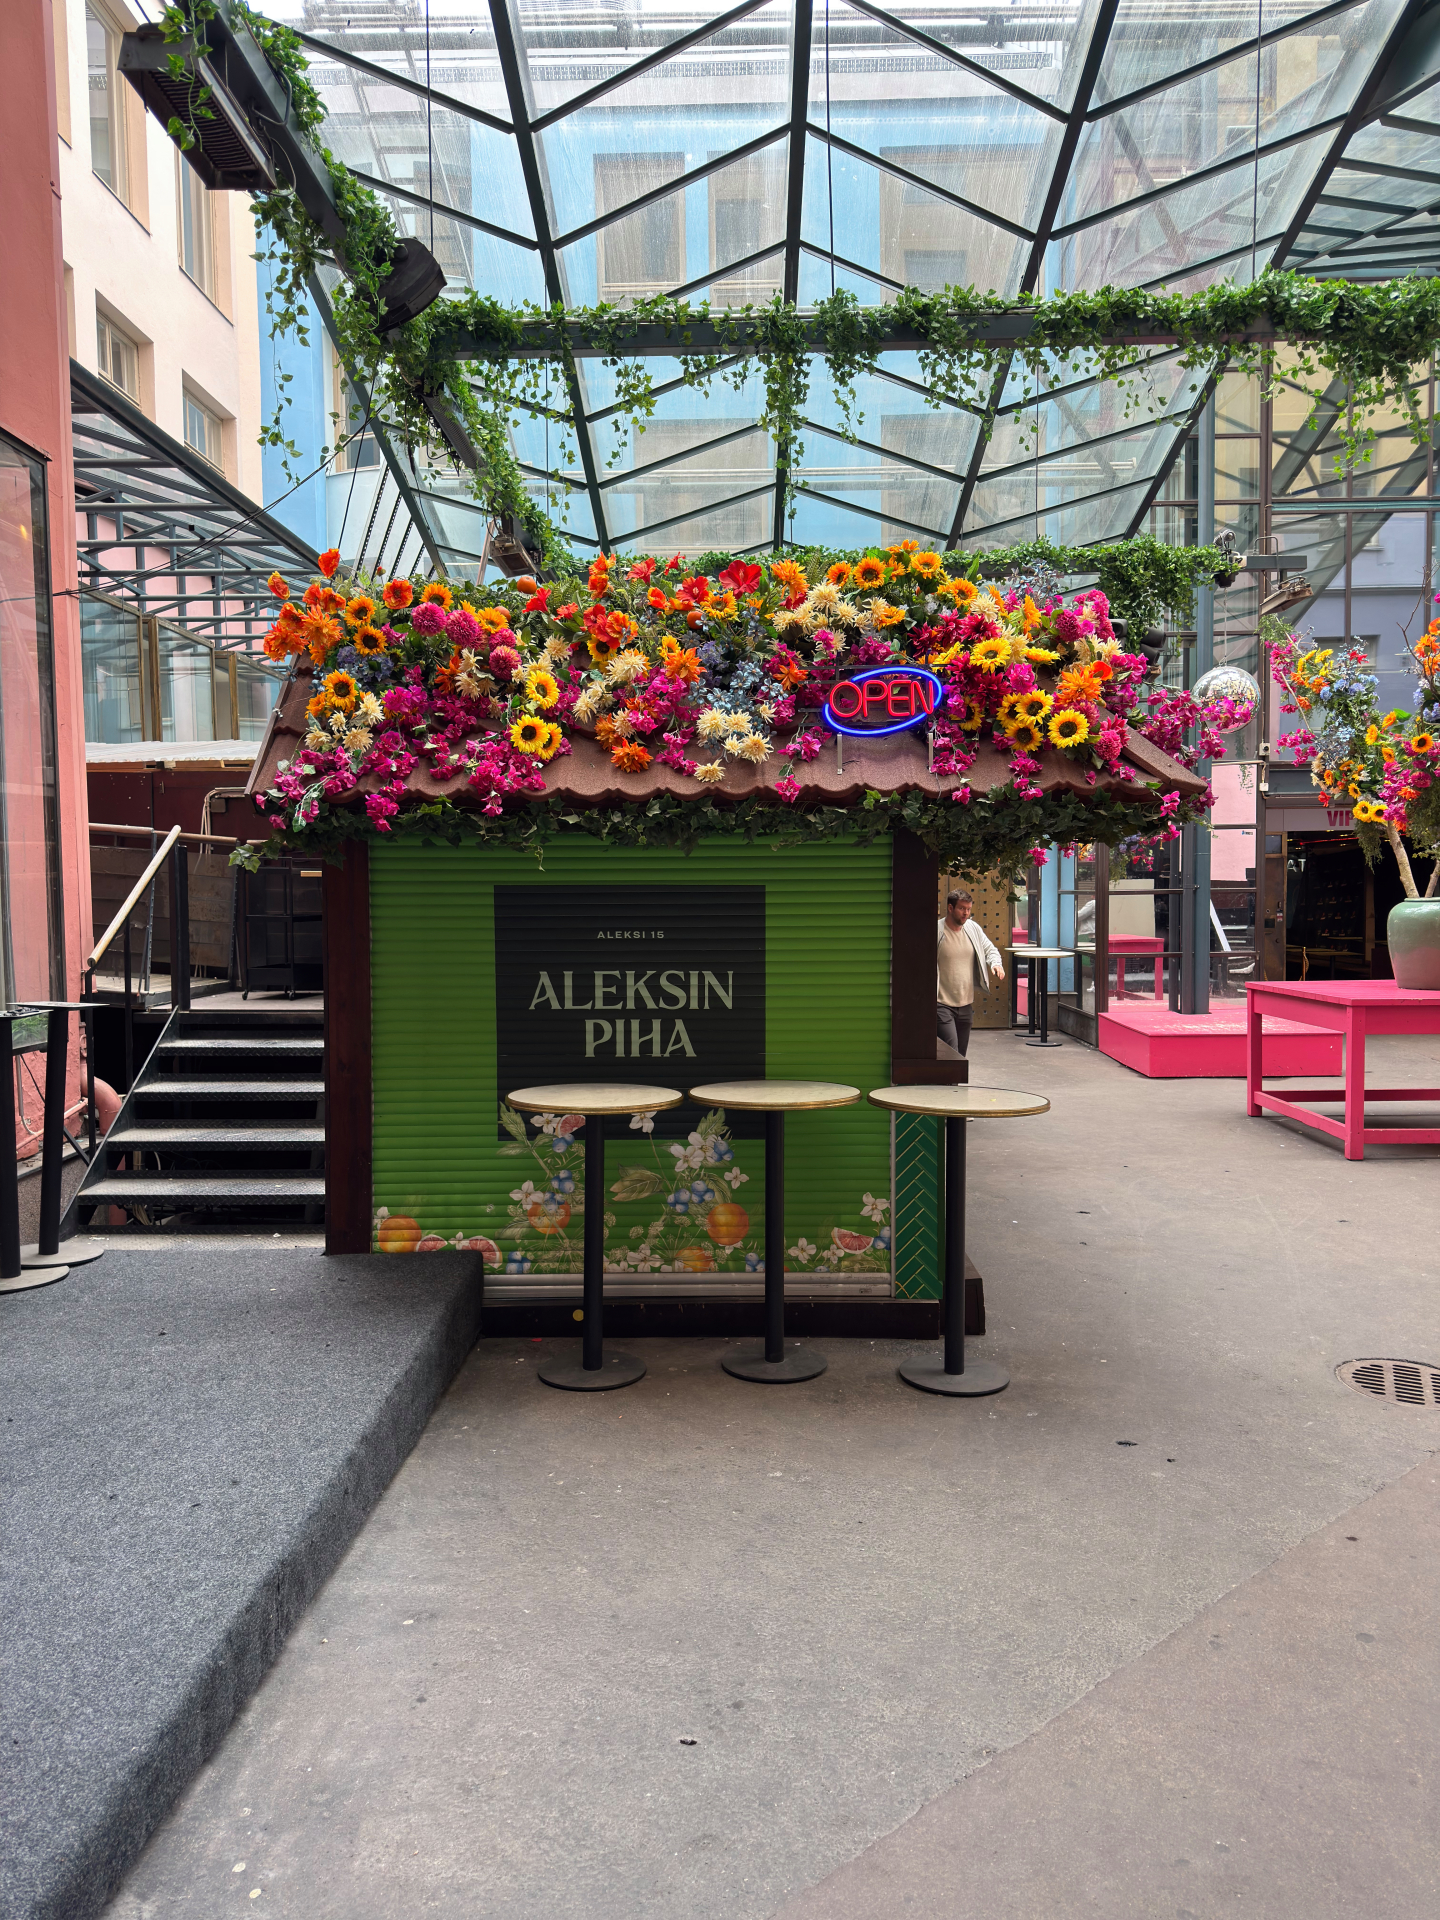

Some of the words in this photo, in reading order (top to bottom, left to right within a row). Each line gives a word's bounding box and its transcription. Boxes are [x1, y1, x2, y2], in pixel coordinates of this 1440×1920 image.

[829, 680, 934, 718] OPEN
[1326, 810, 1355, 826] VIP
[597, 930, 646, 939] ALEKSI
[650, 930, 665, 939] 15
[528, 969, 734, 1010] ALEKSIN
[584, 1018, 697, 1058] PIHA
